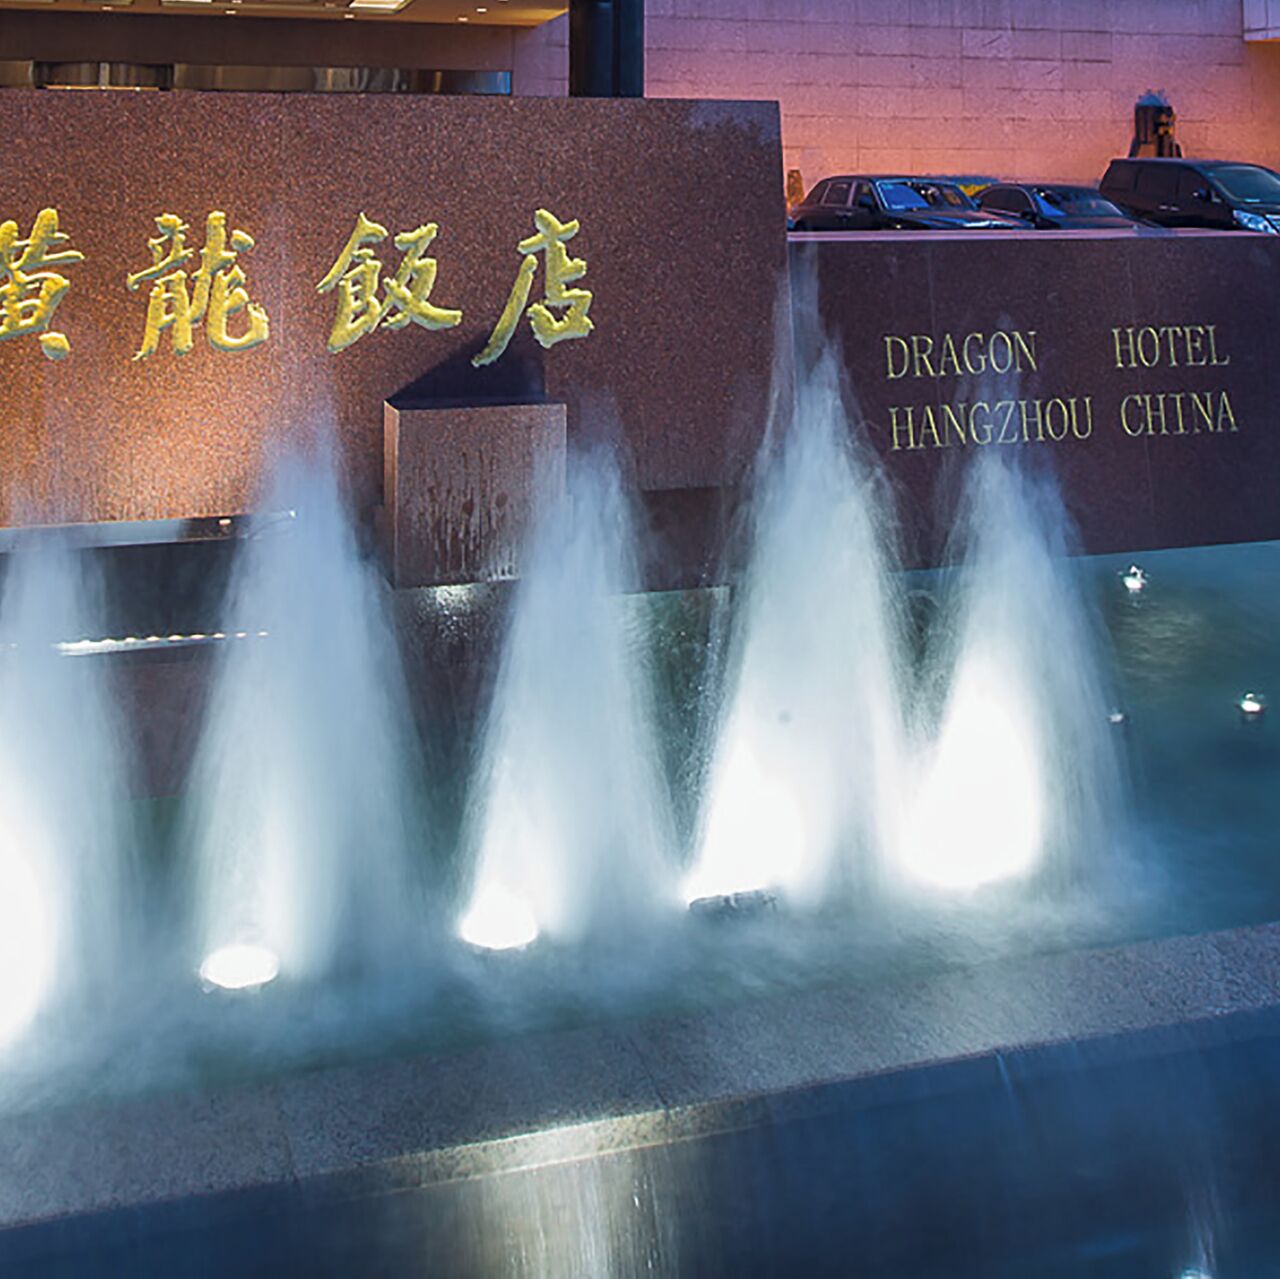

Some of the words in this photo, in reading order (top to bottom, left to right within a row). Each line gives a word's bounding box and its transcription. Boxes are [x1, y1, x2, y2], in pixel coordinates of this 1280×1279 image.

[883, 330, 1038, 380] DRAGON
[1111, 324, 1231, 369] HOTEL
[888, 396, 1093, 450] HANGZHOU
[1120, 391, 1240, 437] CHINA
